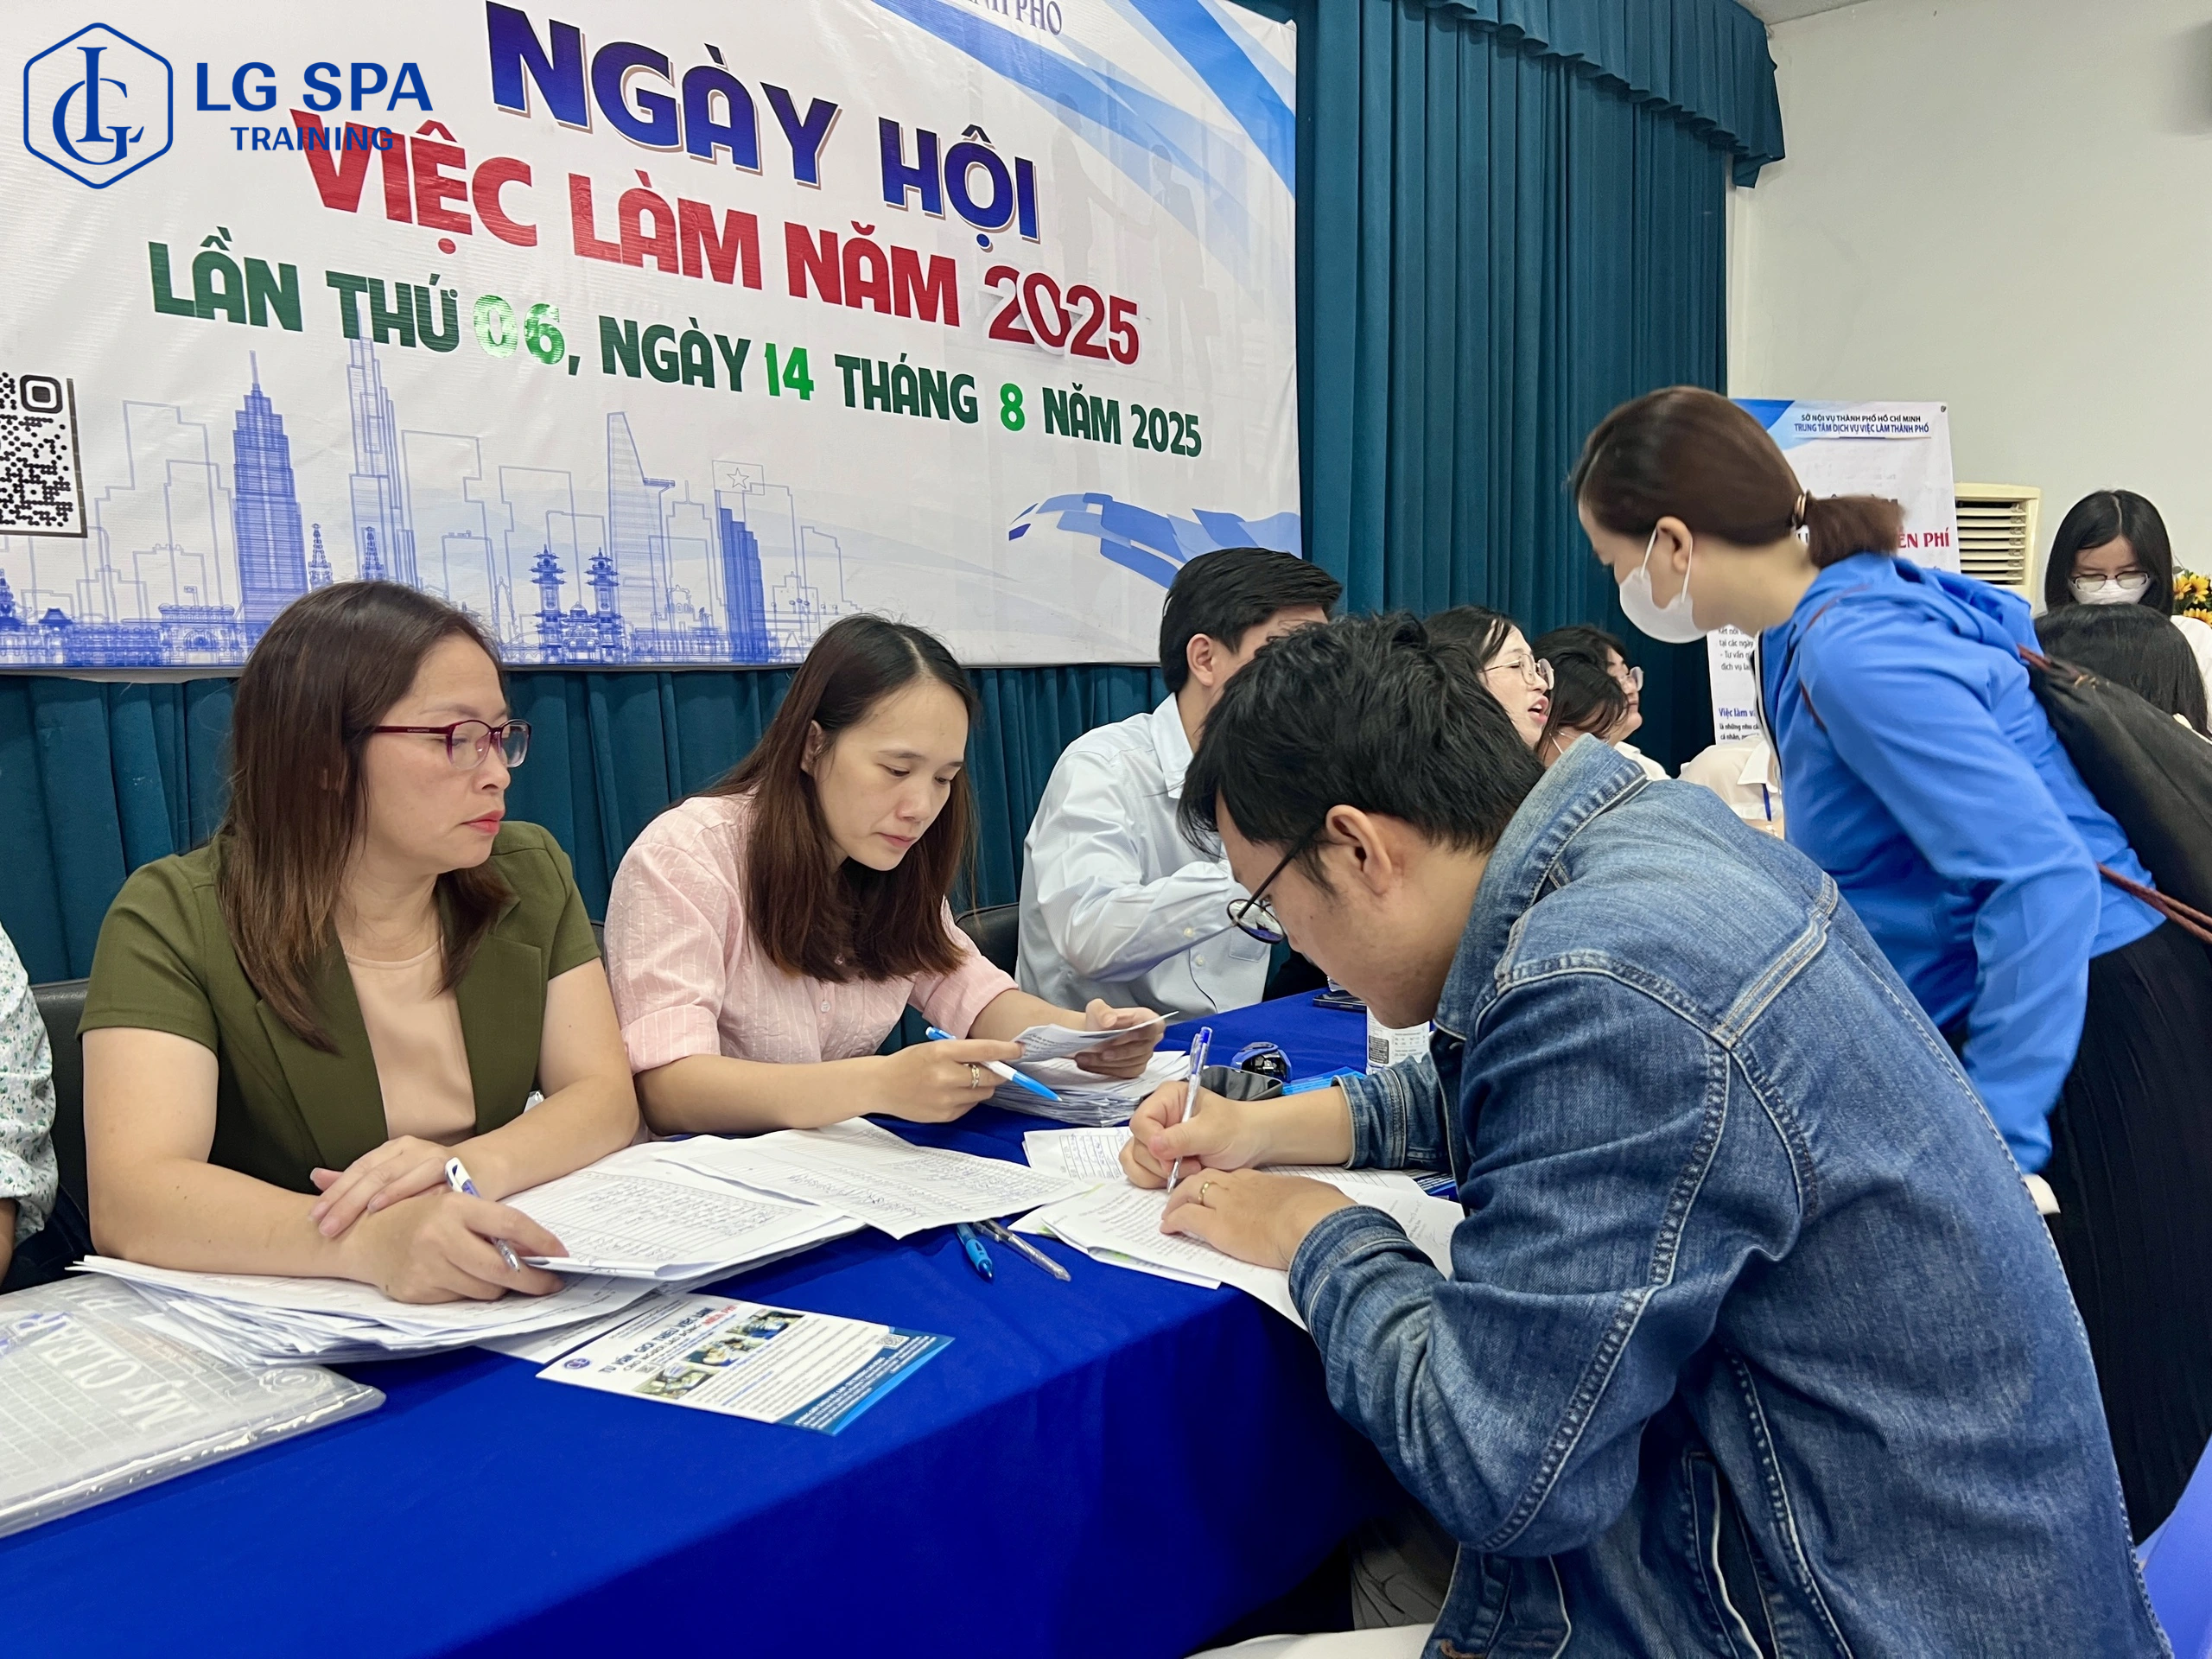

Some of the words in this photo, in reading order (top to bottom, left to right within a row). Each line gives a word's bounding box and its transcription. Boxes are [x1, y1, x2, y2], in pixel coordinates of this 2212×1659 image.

[485, 0, 839, 187] NGÀY
[879, 118, 1039, 250] HỘI
[289, 108, 538, 254] VIỆC
[569, 171, 762, 290] LÀM
[785, 220, 960, 327] NĂM
[983, 265, 1140, 365] 2025
[149, 226, 302, 332] LẦN
[326, 273, 461, 353] THỨ
[598, 315, 751, 393] NGÀY
[764, 343, 815, 401] 14
[835, 353, 978, 423] THÁNG
[1000, 384, 1026, 431] 8
[1042, 383, 1122, 445] NĂM
[1130, 404, 1202, 457] 2025
[1794, 423, 1817, 432] TRUNG
[1818, 423, 1832, 432] TÂM
[1833, 423, 1849, 435] DỊCH
[1850, 424, 1859, 435] VỤ
[1859, 423, 1875, 435] VIỆC
[1876, 423, 1891, 433] LÀM
[1891, 423, 1914, 433] THÀNH
[1915, 422, 1929, 433] PHỐ
[1812, 413, 1825, 423] NỘI
[1825, 415, 1835, 423] VỤ
[1923, 527, 1949, 548] PHÍ
[1719, 708, 1733, 720] Việc
[1733, 708, 1748, 717] làm
